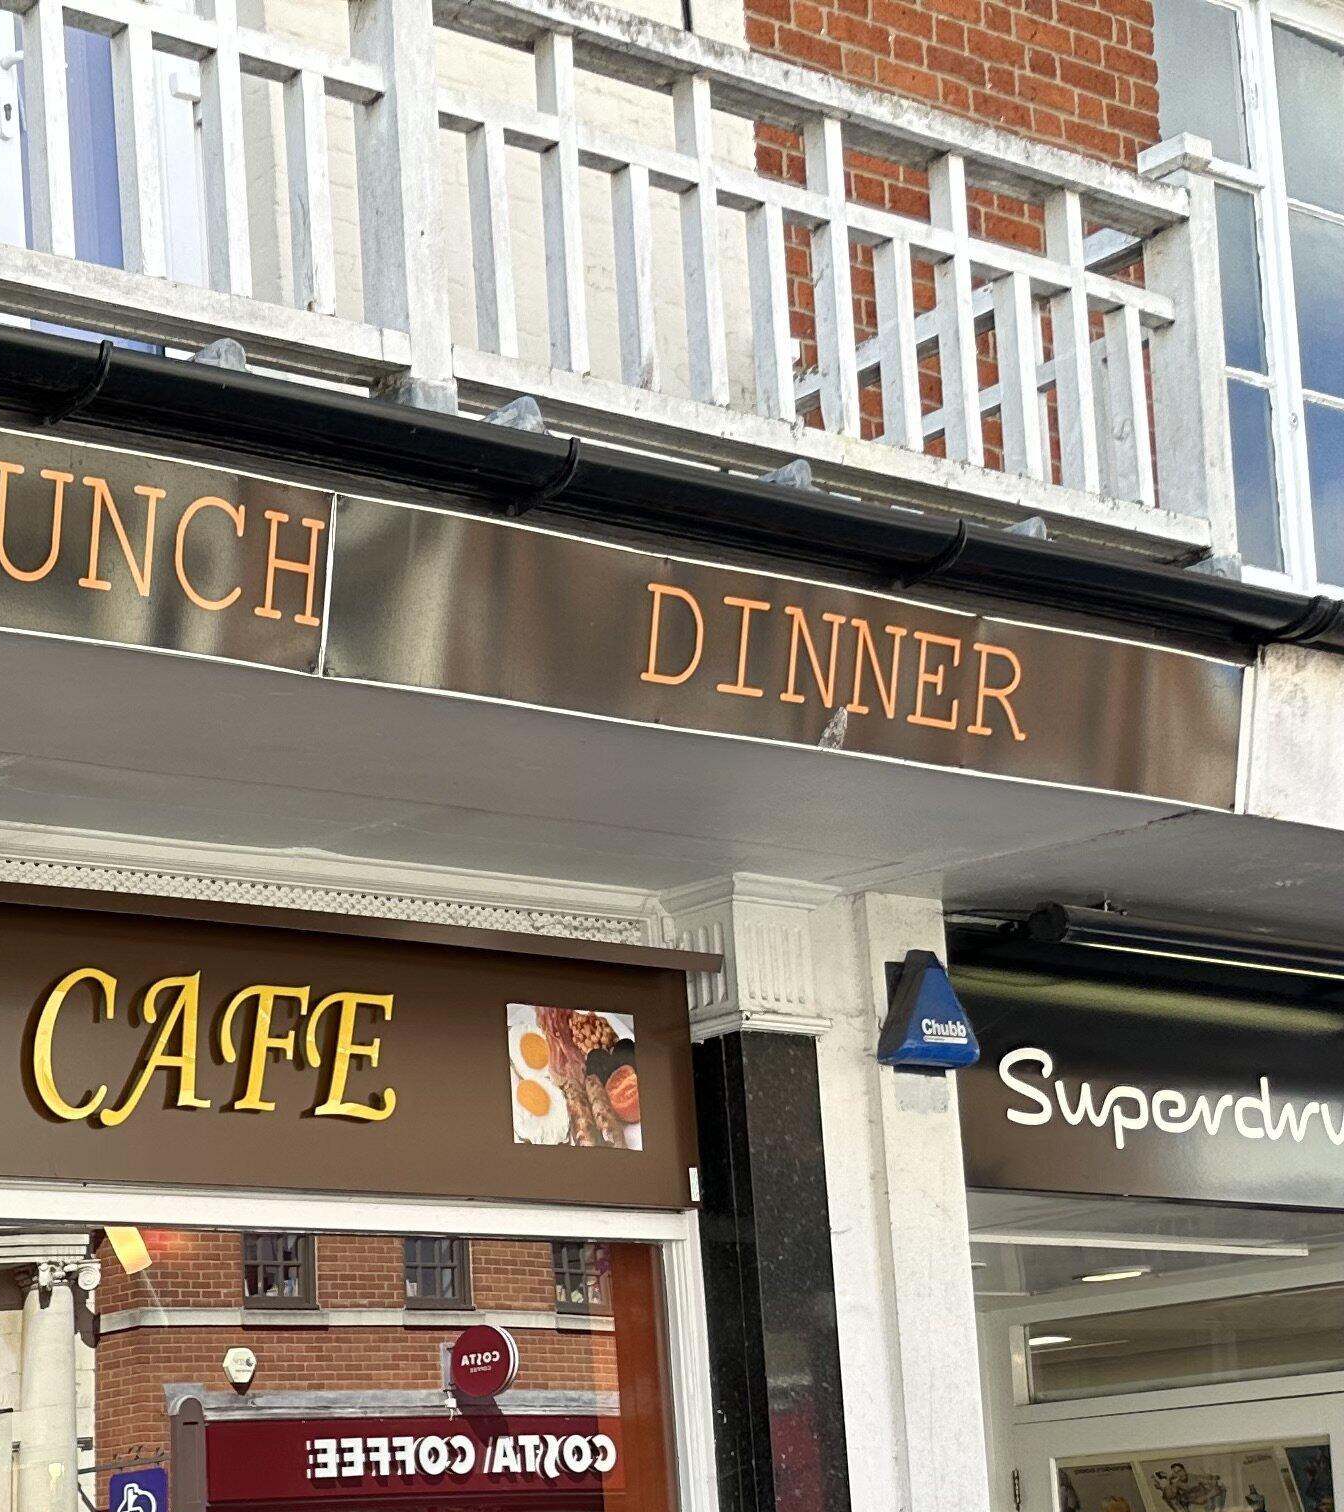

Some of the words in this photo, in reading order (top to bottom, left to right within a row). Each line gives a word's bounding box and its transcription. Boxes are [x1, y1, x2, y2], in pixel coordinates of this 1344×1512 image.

[639, 582, 1028, 742] DINNER
[28, 967, 397, 1126] CAFE
[921, 1017, 967, 1038] Chubb
[999, 1047, 1344, 1149] Superdru
